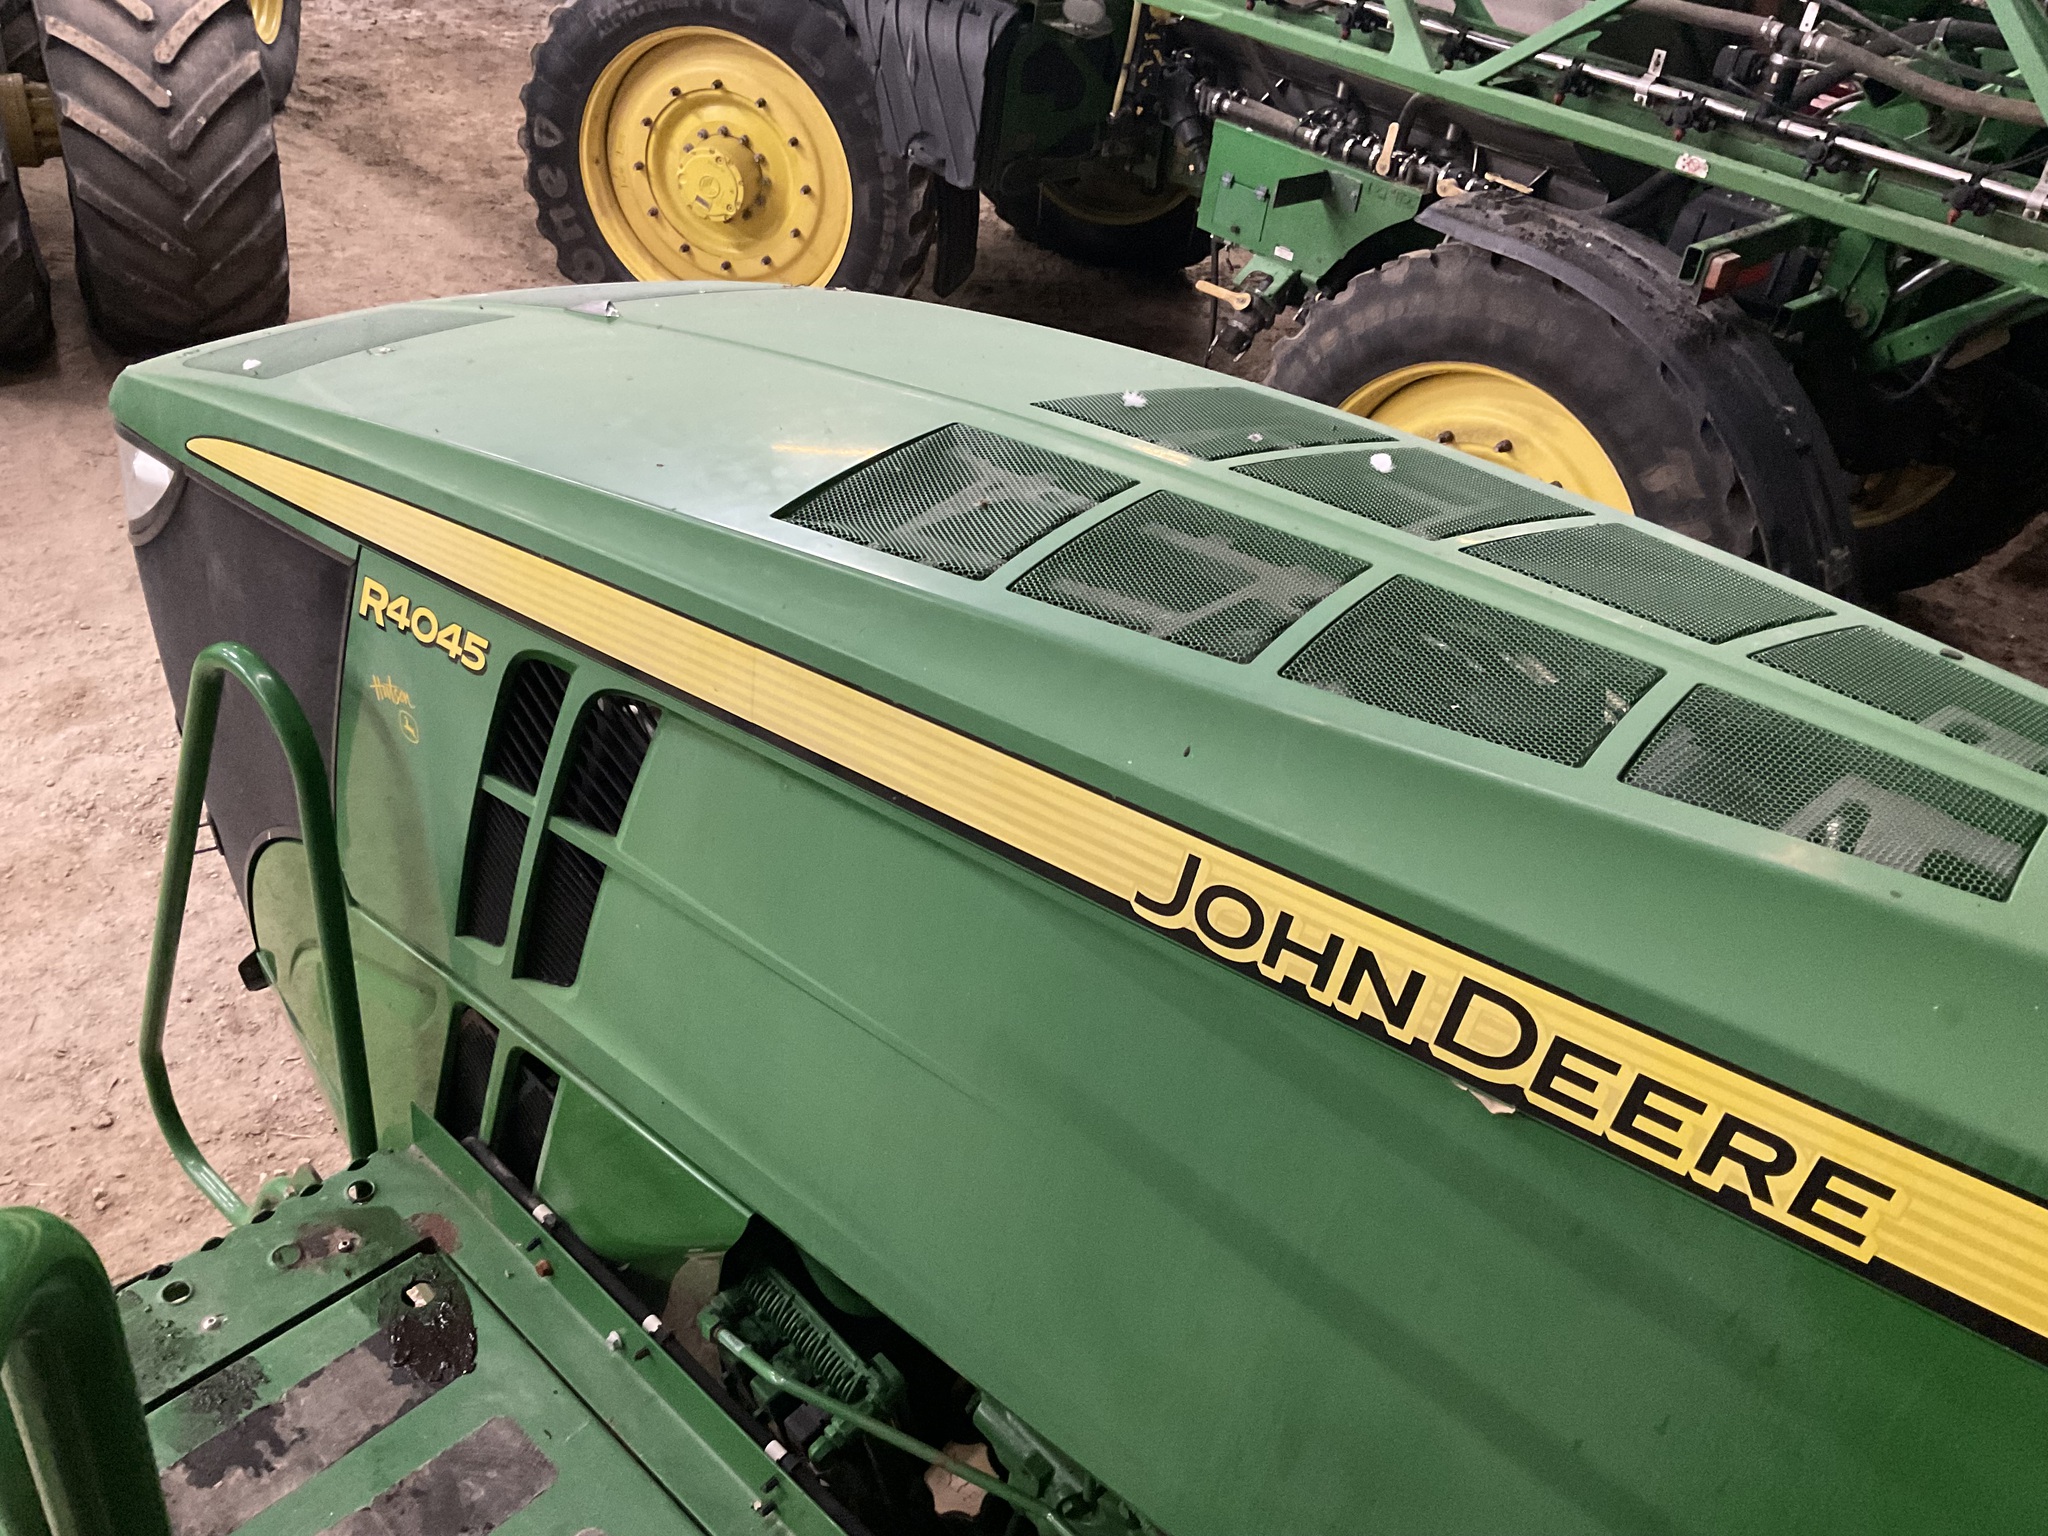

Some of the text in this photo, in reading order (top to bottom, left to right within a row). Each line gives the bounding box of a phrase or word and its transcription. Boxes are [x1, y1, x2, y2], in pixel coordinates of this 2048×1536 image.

[358, 576, 491, 675] R4045
[1134, 853, 1897, 1248] JOHN DEERE
